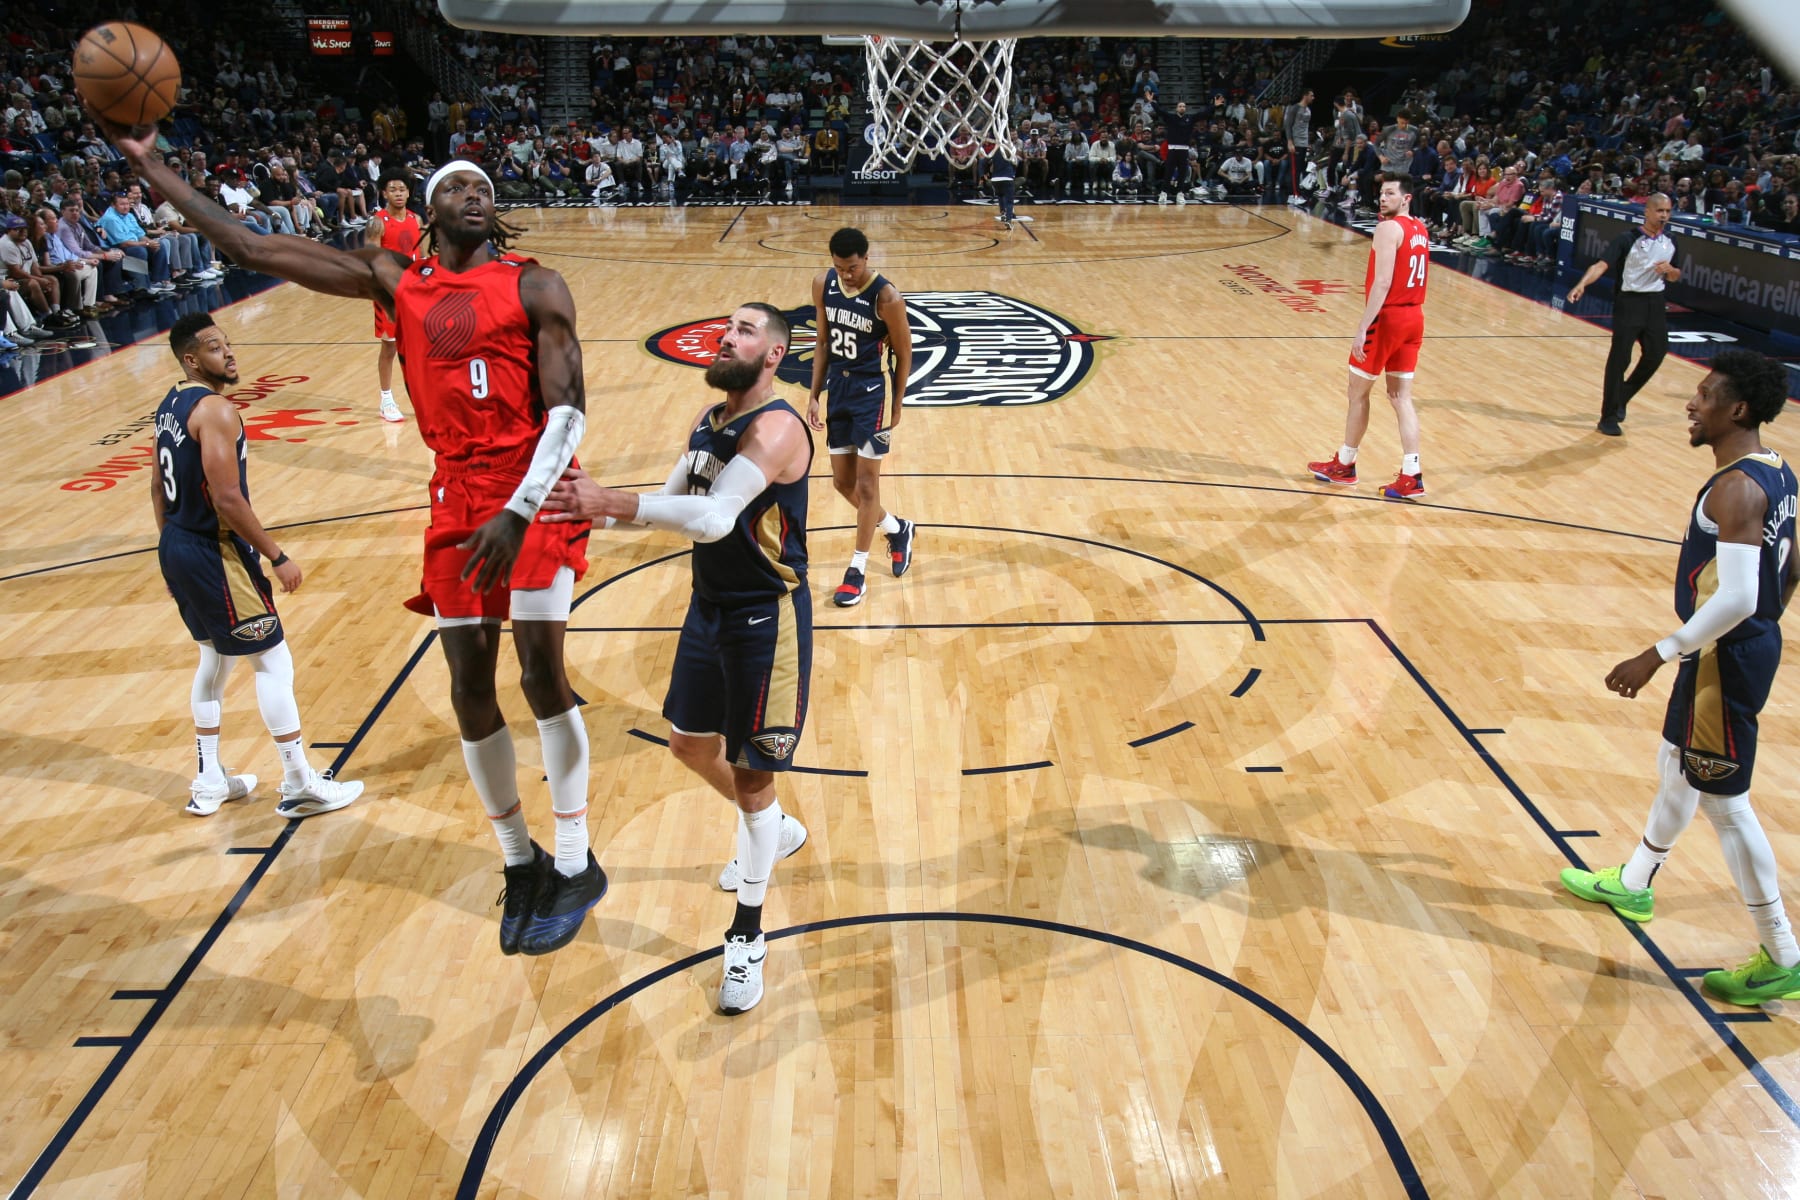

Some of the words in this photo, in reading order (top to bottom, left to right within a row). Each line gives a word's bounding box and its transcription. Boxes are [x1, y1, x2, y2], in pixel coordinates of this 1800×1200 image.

[852, 171, 898, 180] TISSOT
[1561, 229, 1574, 242] GEEK
[1562, 217, 1575, 230] SEAT
[1407, 254, 1425, 288] 24
[1681, 254, 1761, 305] America
[1761, 280, 1800, 318] reli
[1270, 294, 1327, 313] KING
[837, 308, 873, 334] ORLEANS
[830, 327, 857, 360] 25
[469, 358, 488, 399] 9
[902, 325, 1063, 405] ORLEANS
[89, 411, 156, 446] ENTER
[160, 446, 176, 502] 3
[1777, 536, 1792, 575] 9
